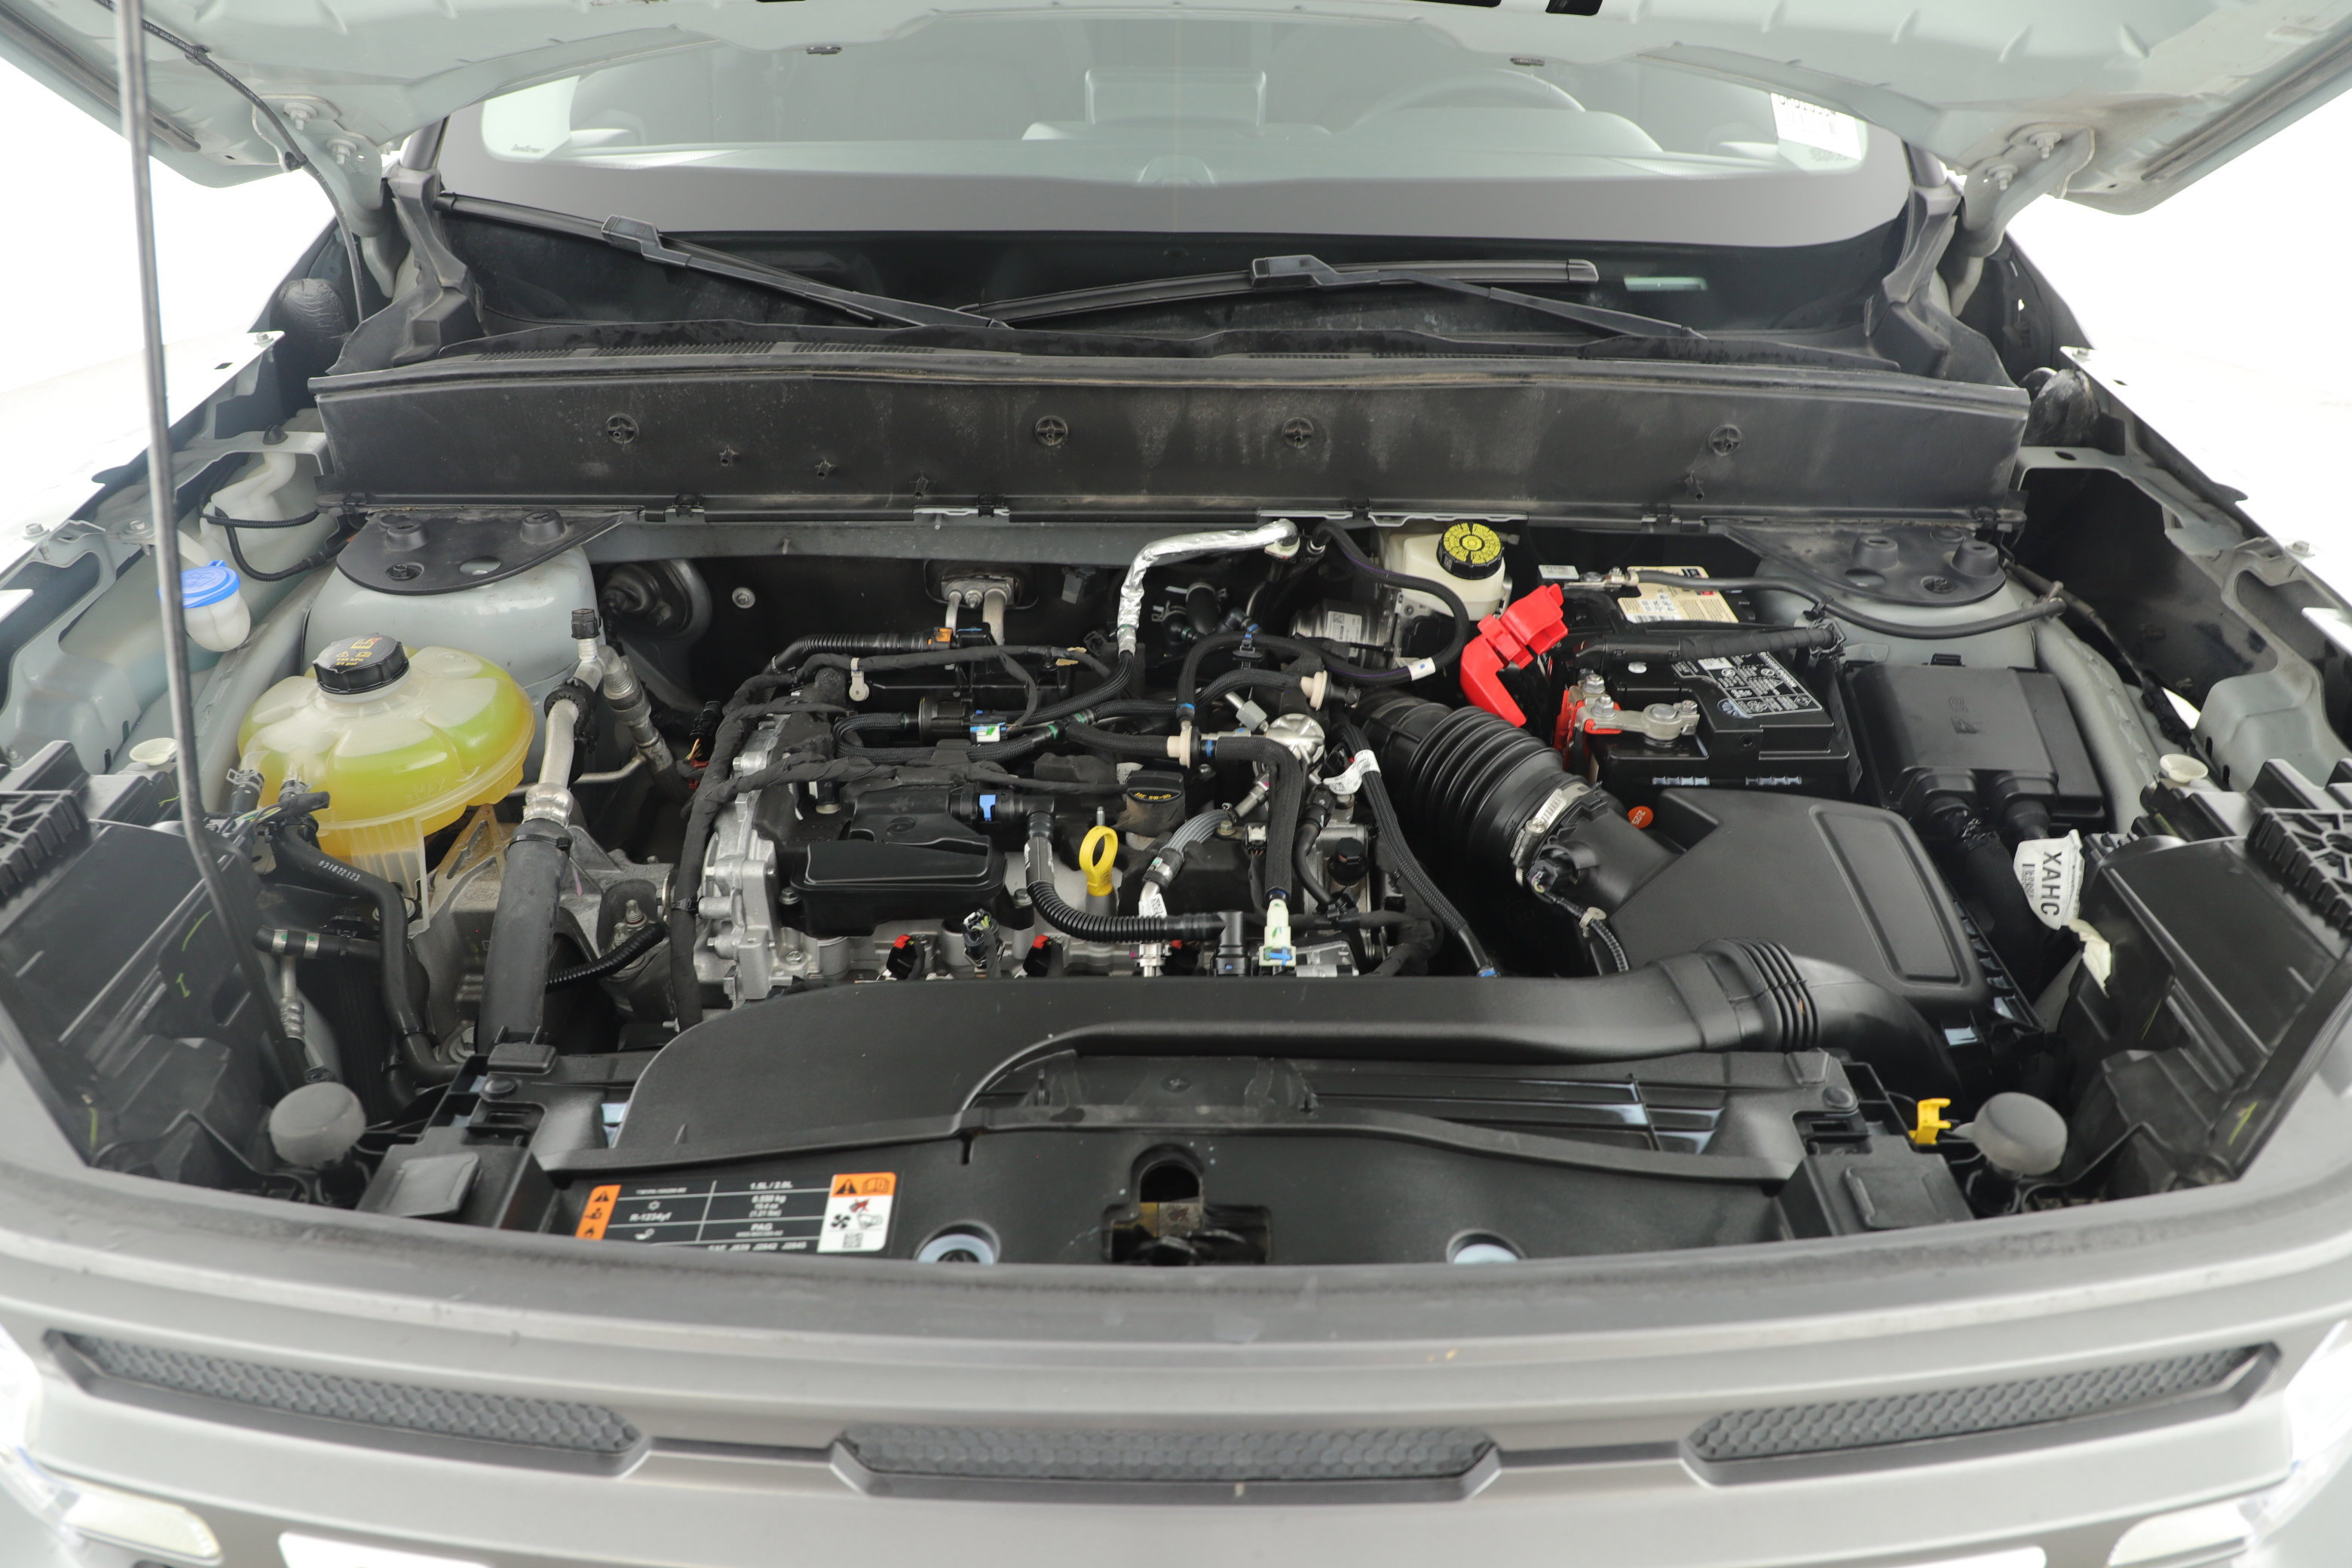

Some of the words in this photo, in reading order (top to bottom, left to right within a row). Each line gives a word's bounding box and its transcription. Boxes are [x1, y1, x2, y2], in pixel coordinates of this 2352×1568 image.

[2041, 851, 2063, 915] XAHC
[775, 1194, 787, 1204] kg
[629, 1211, 672, 1222] R-1234yf
[750, 1222, 773, 1231] PAG
